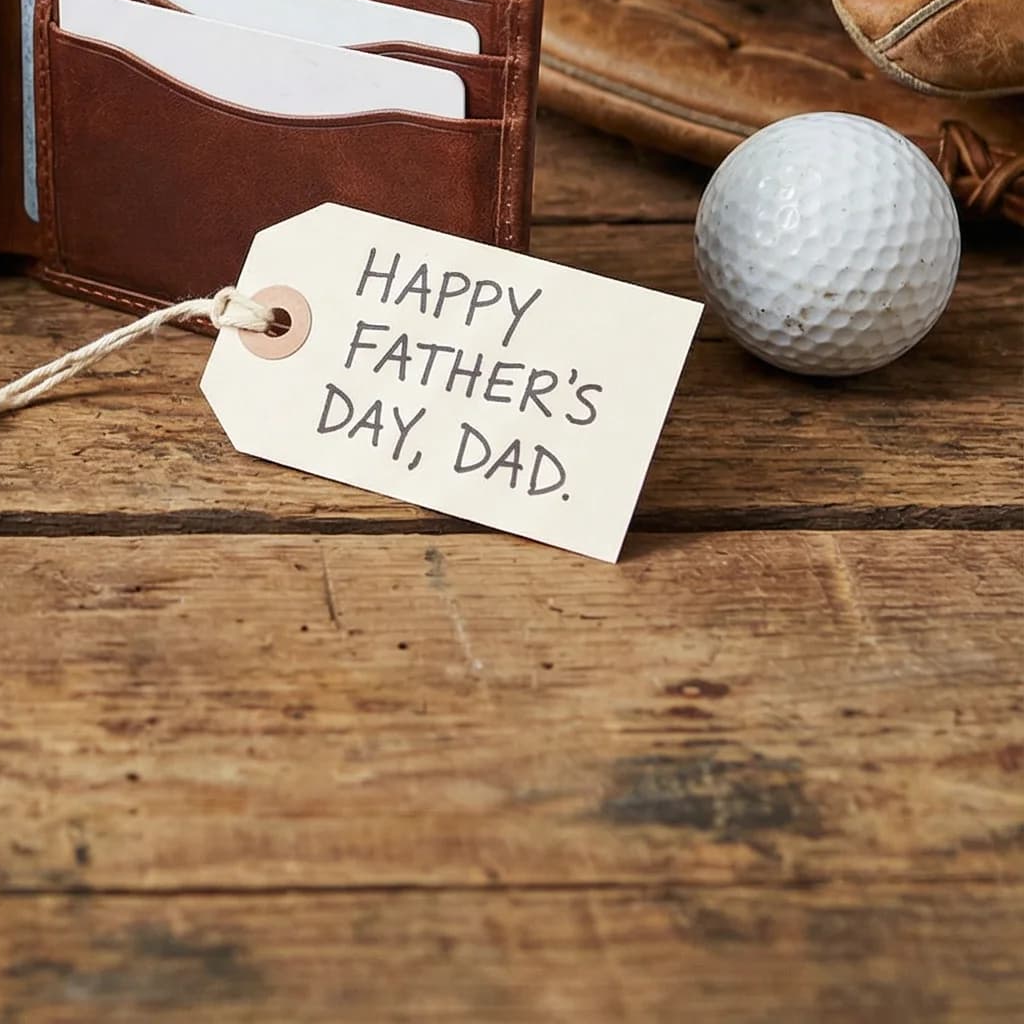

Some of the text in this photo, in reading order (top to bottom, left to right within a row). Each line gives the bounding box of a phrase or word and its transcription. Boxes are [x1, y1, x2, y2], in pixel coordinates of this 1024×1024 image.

[356, 247, 543, 347] HAPPY
[344, 320, 603, 426] FATHER'S
[316, 383, 571, 502] DAY, DAD.
